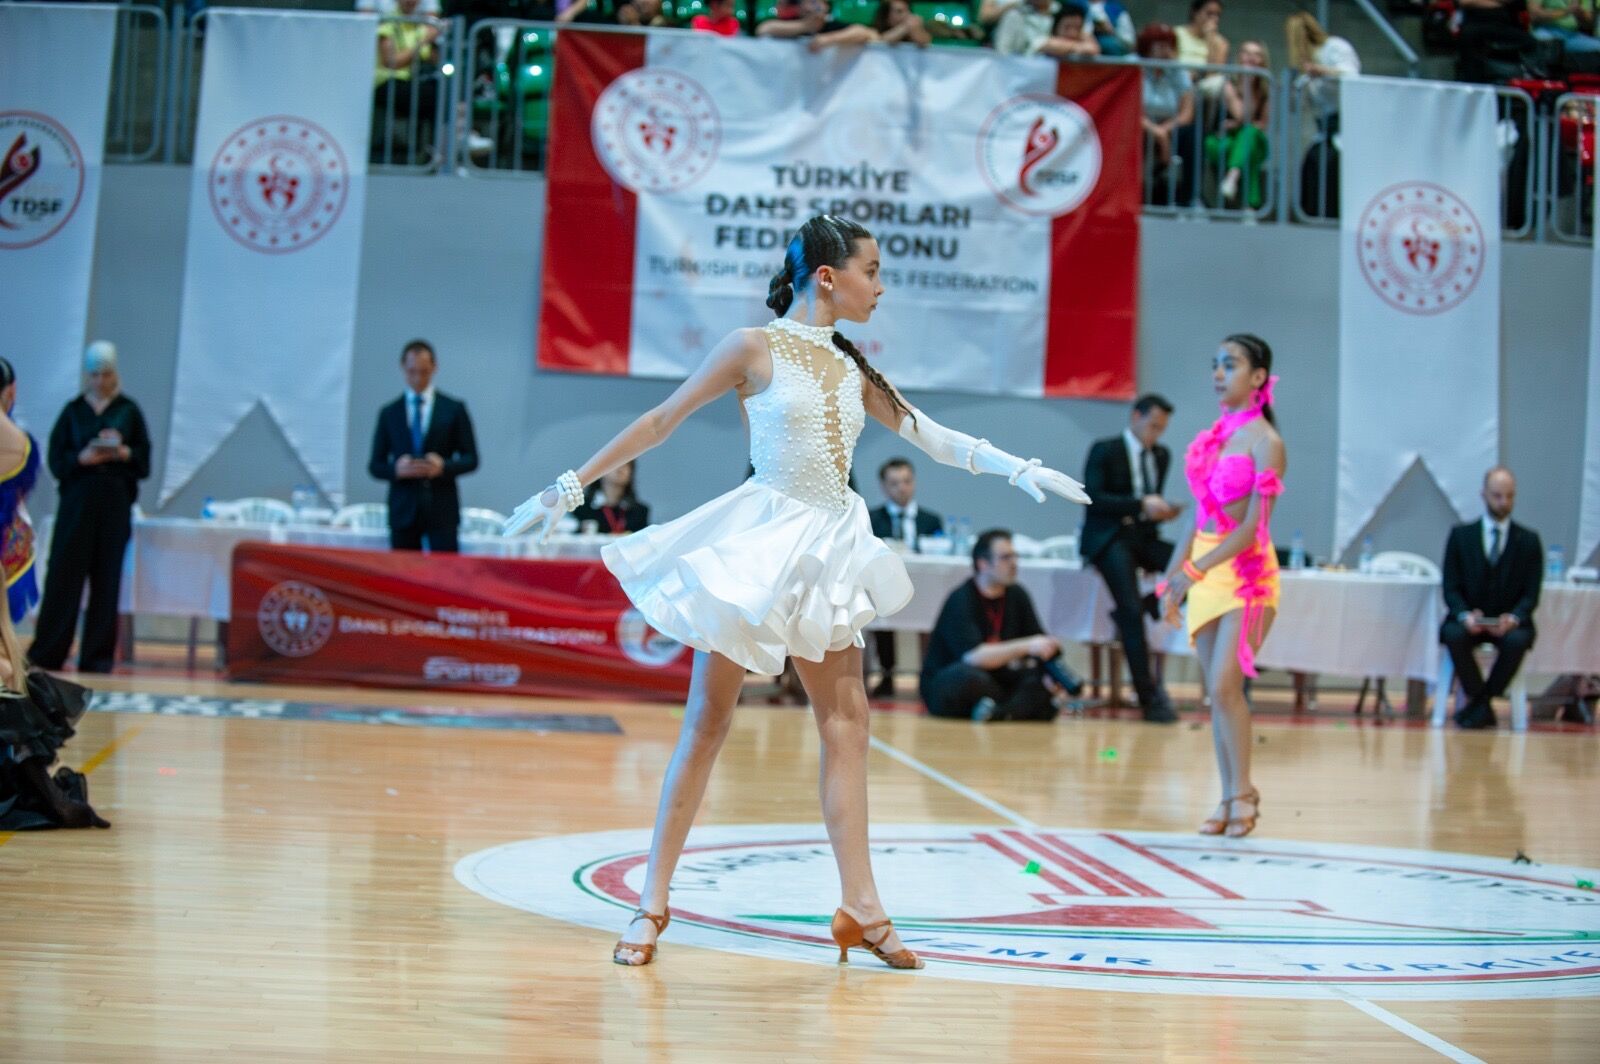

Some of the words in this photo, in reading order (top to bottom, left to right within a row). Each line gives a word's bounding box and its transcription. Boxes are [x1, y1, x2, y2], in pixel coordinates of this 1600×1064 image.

[772, 160, 910, 193] TÜRKİYE
[11, 197, 62, 216] TDSF
[807, 196, 971, 228] SPORLARI
[715, 224, 959, 260] FEDONU
